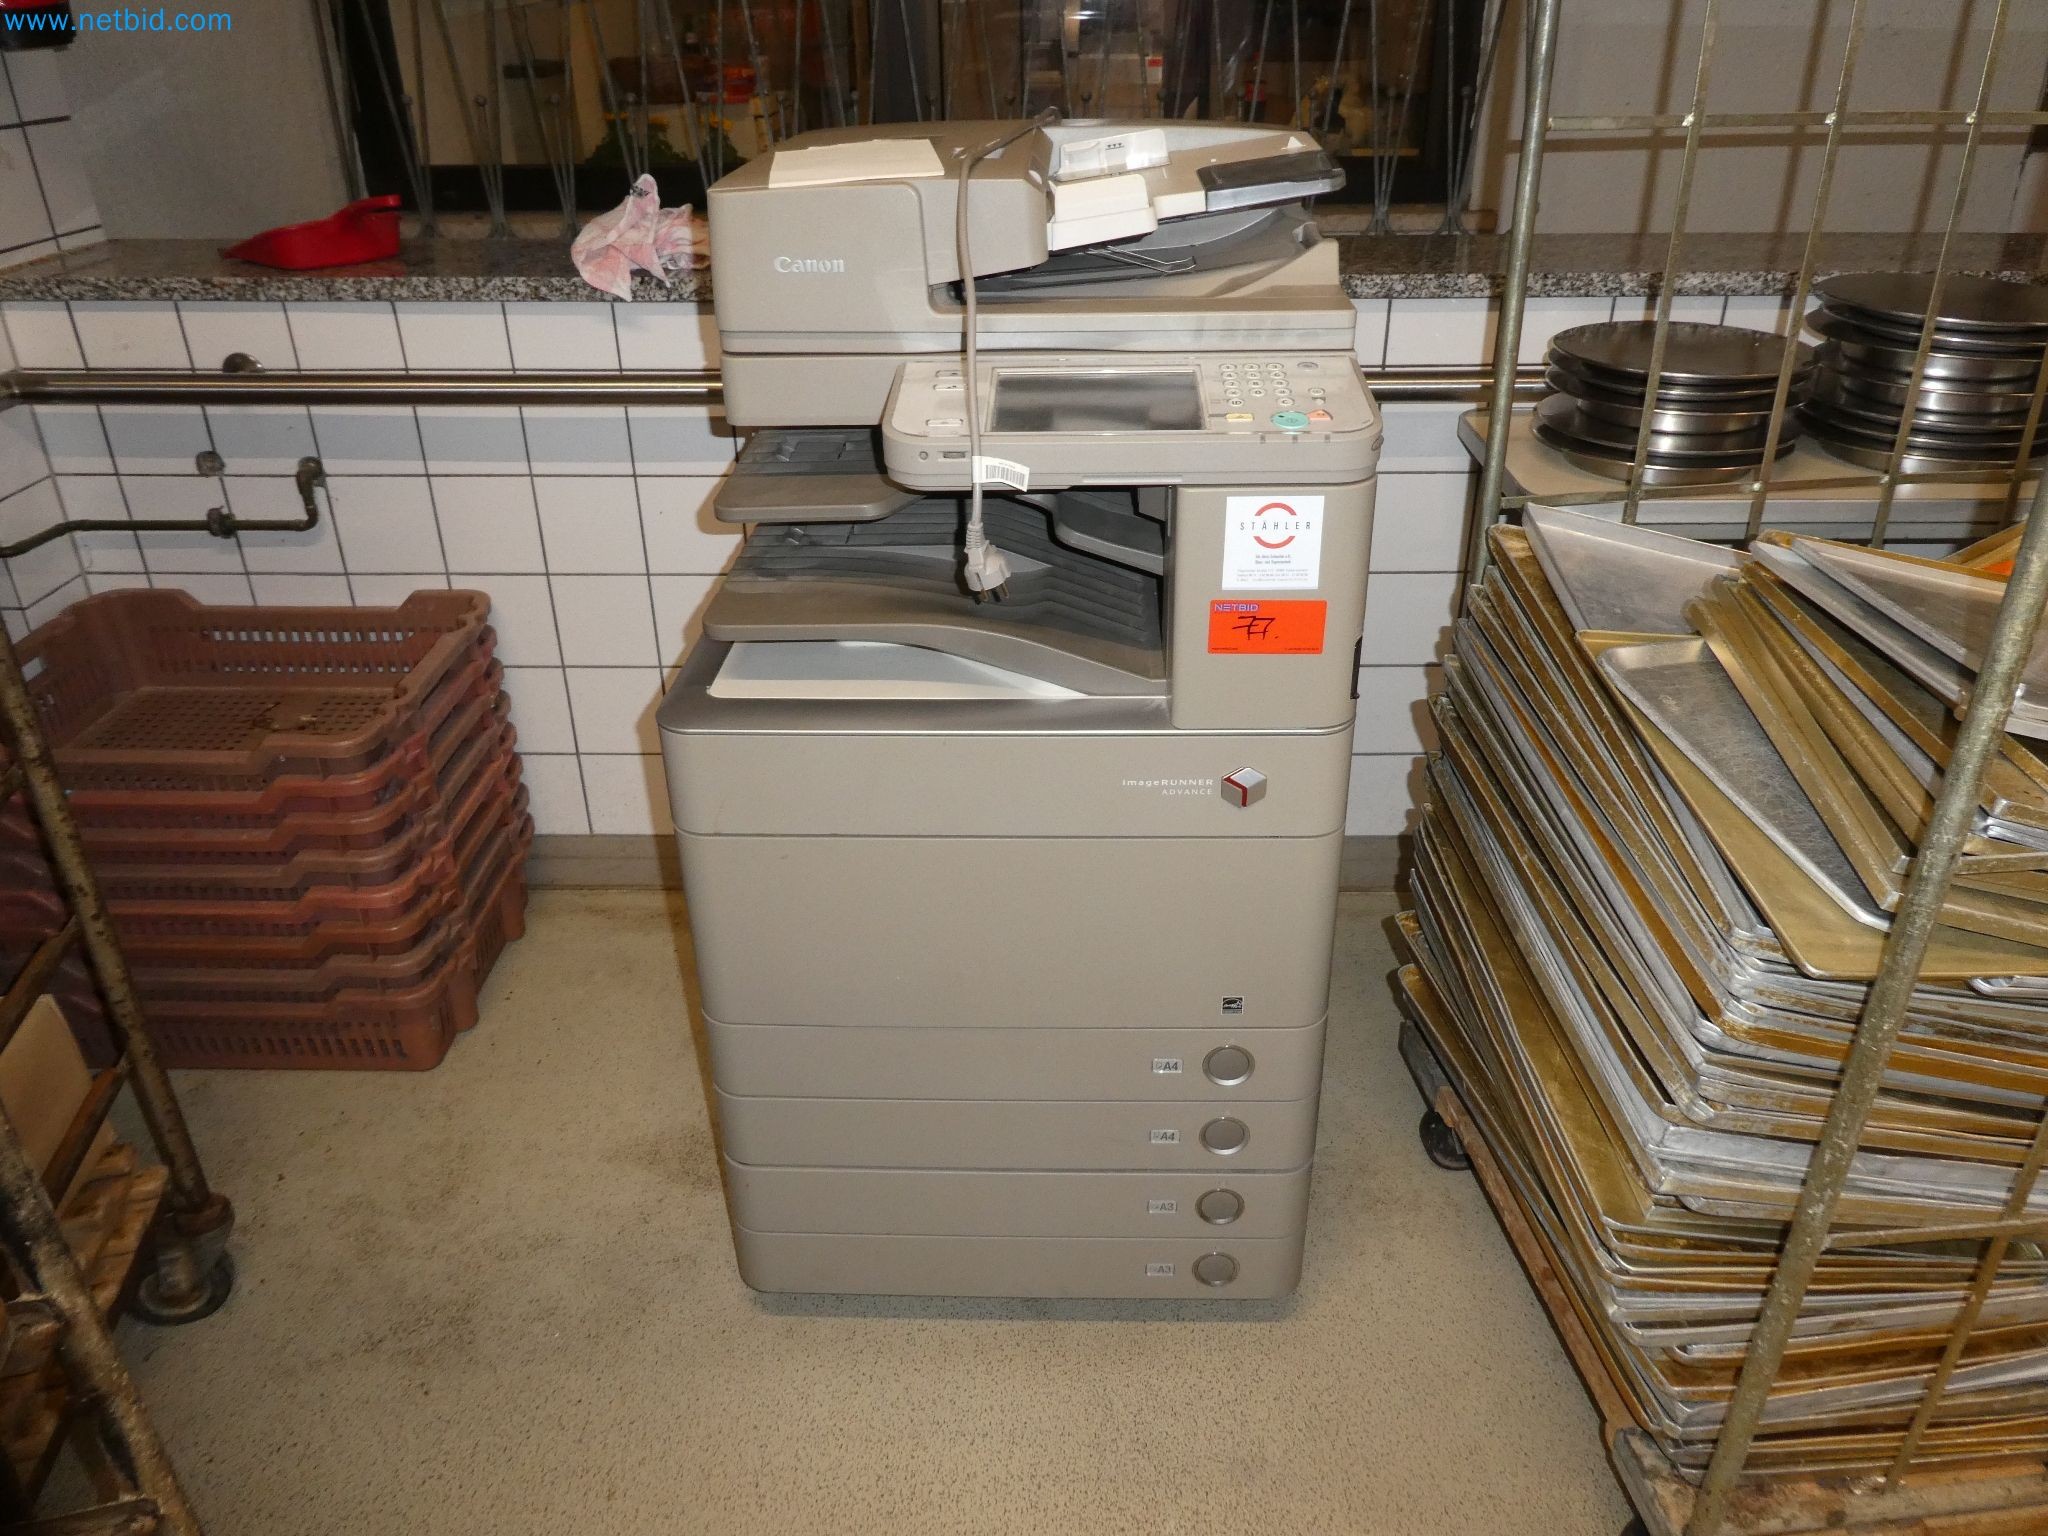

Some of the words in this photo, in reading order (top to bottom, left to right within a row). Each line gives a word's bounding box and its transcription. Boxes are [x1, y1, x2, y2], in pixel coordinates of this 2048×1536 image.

[774, 256, 845, 272] Canon
[1240, 519, 1311, 531] STÄHLER
[1214, 603, 1260, 612] NETBID
[1121, 778, 1214, 788] imageRUNNER
[1161, 788, 1213, 796] ADVANCE
[1163, 1060, 1178, 1071] A4
[1160, 1131, 1175, 1141] A4
[1159, 1202, 1174, 1211] A3
